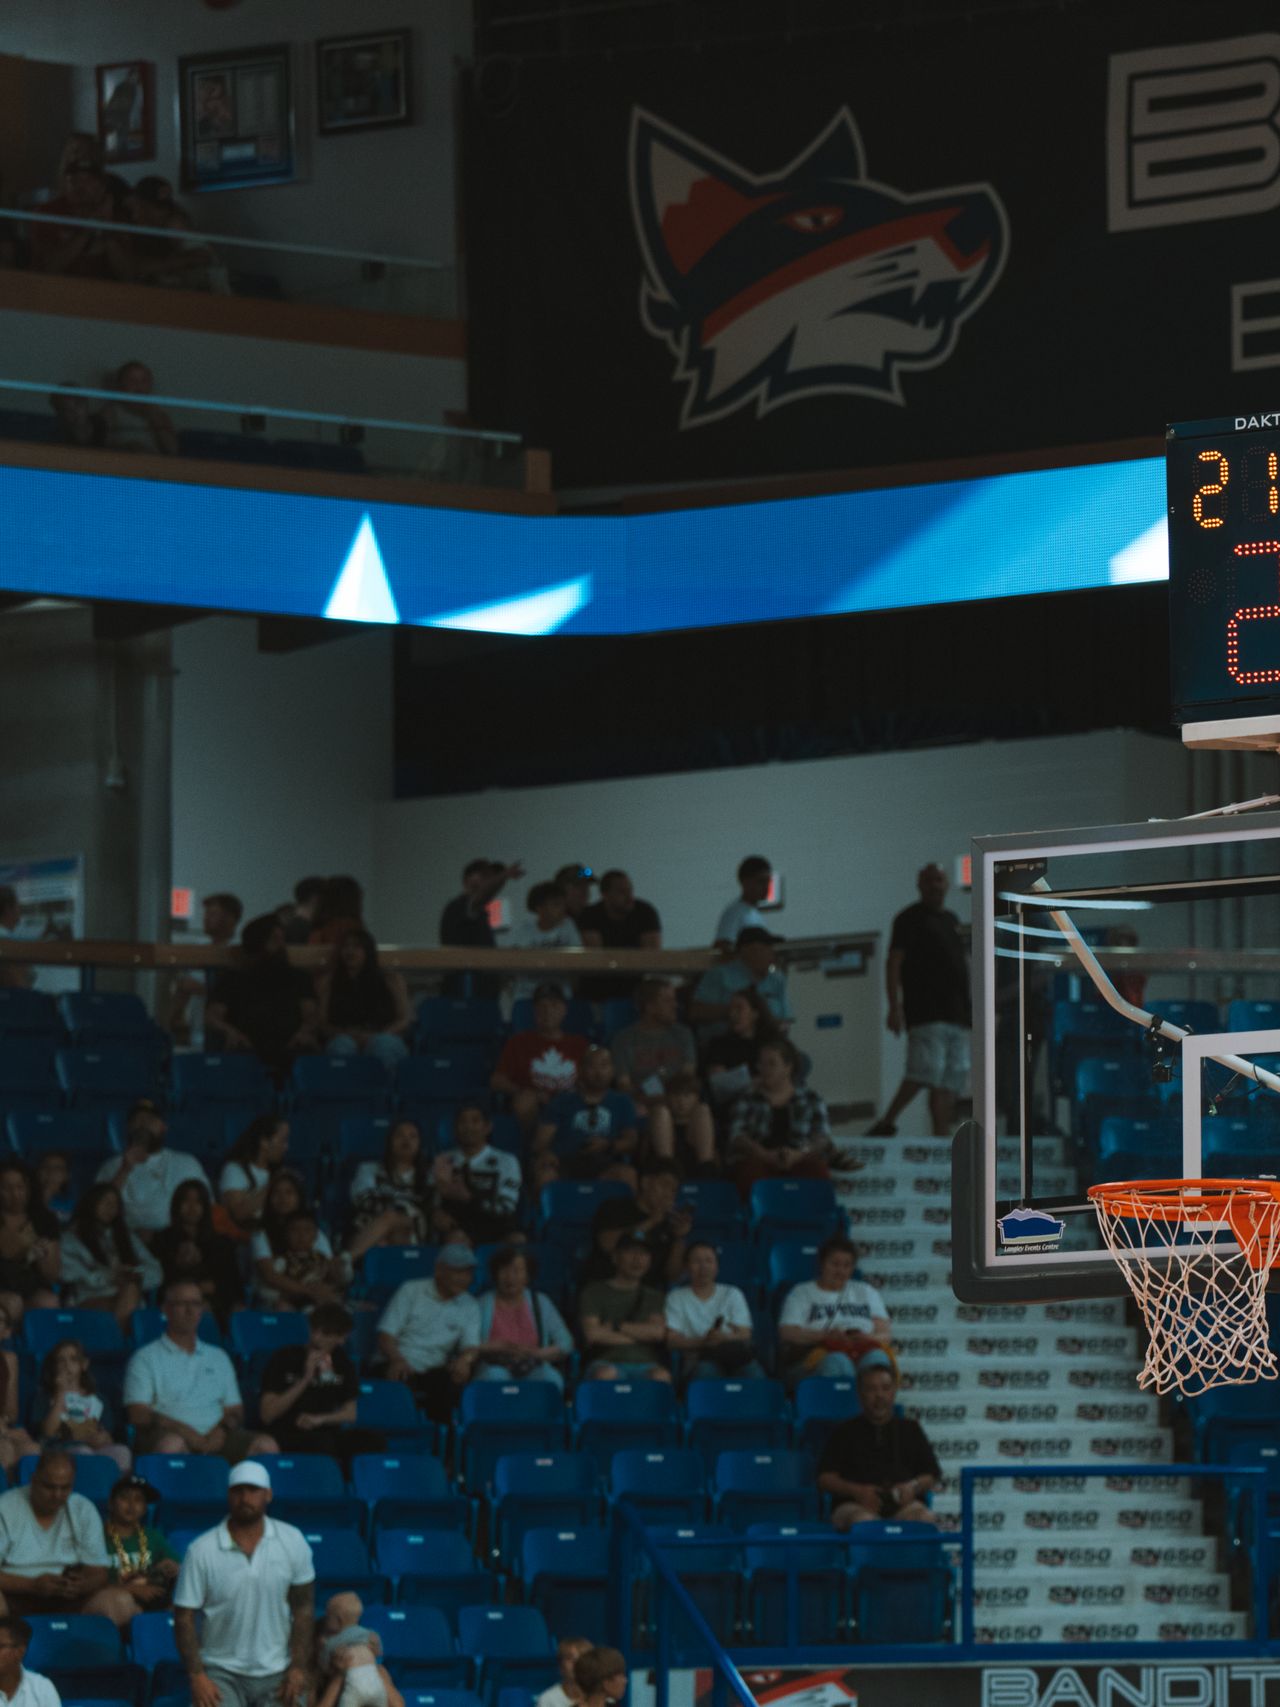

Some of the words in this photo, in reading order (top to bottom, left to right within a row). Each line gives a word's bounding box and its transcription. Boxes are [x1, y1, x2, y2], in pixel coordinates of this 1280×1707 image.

[1004, 1244, 1025, 1254] Langley
[1024, 1243, 1042, 1252] Events
[1041, 1243, 1060, 1251] Centre
